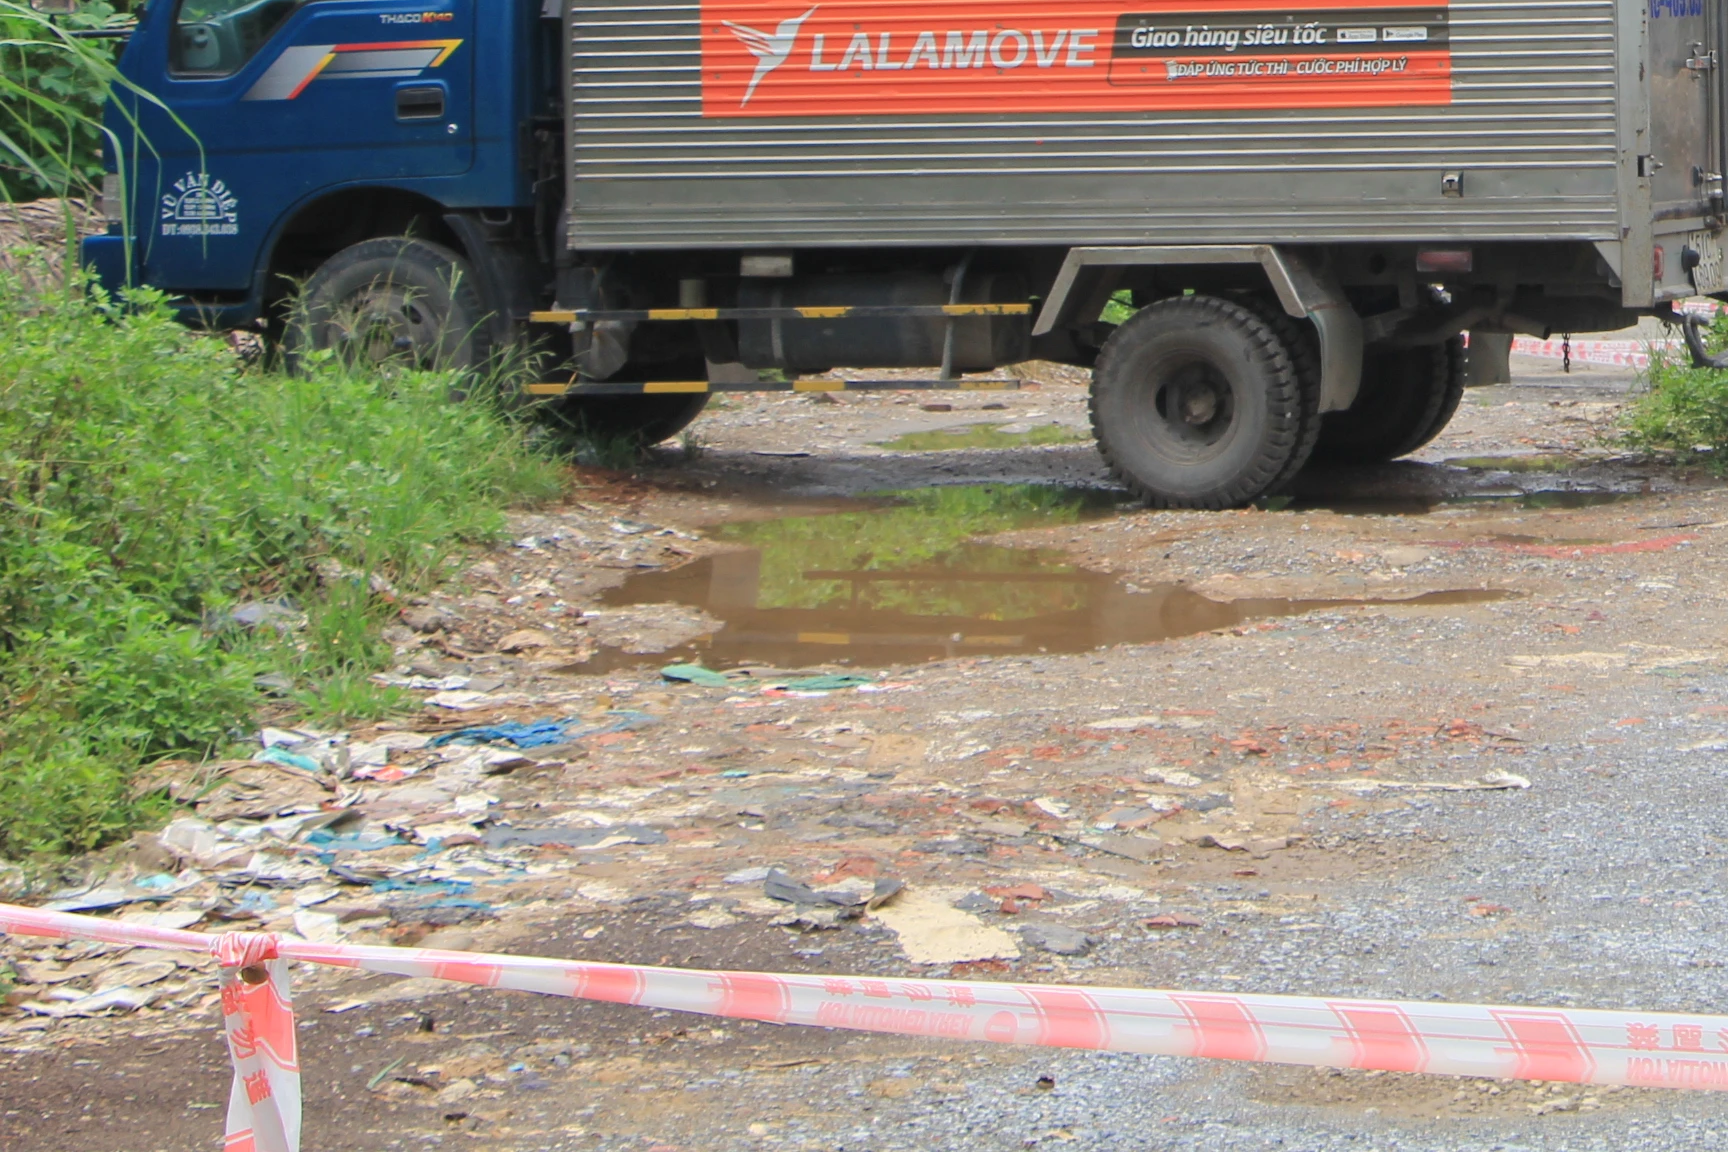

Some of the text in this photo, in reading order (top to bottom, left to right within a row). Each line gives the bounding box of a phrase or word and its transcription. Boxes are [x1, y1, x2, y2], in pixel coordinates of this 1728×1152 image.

[379, 13, 421, 24] THACO
[1131, 21, 1327, 52] Giao hàng siêu tốc
[809, 29, 1098, 71] LALAMOVE
[1177, 55, 1408, 76] ĐÁP ỨNG TỨC THÌ CƯỚC PHÍ HỢP LÝ
